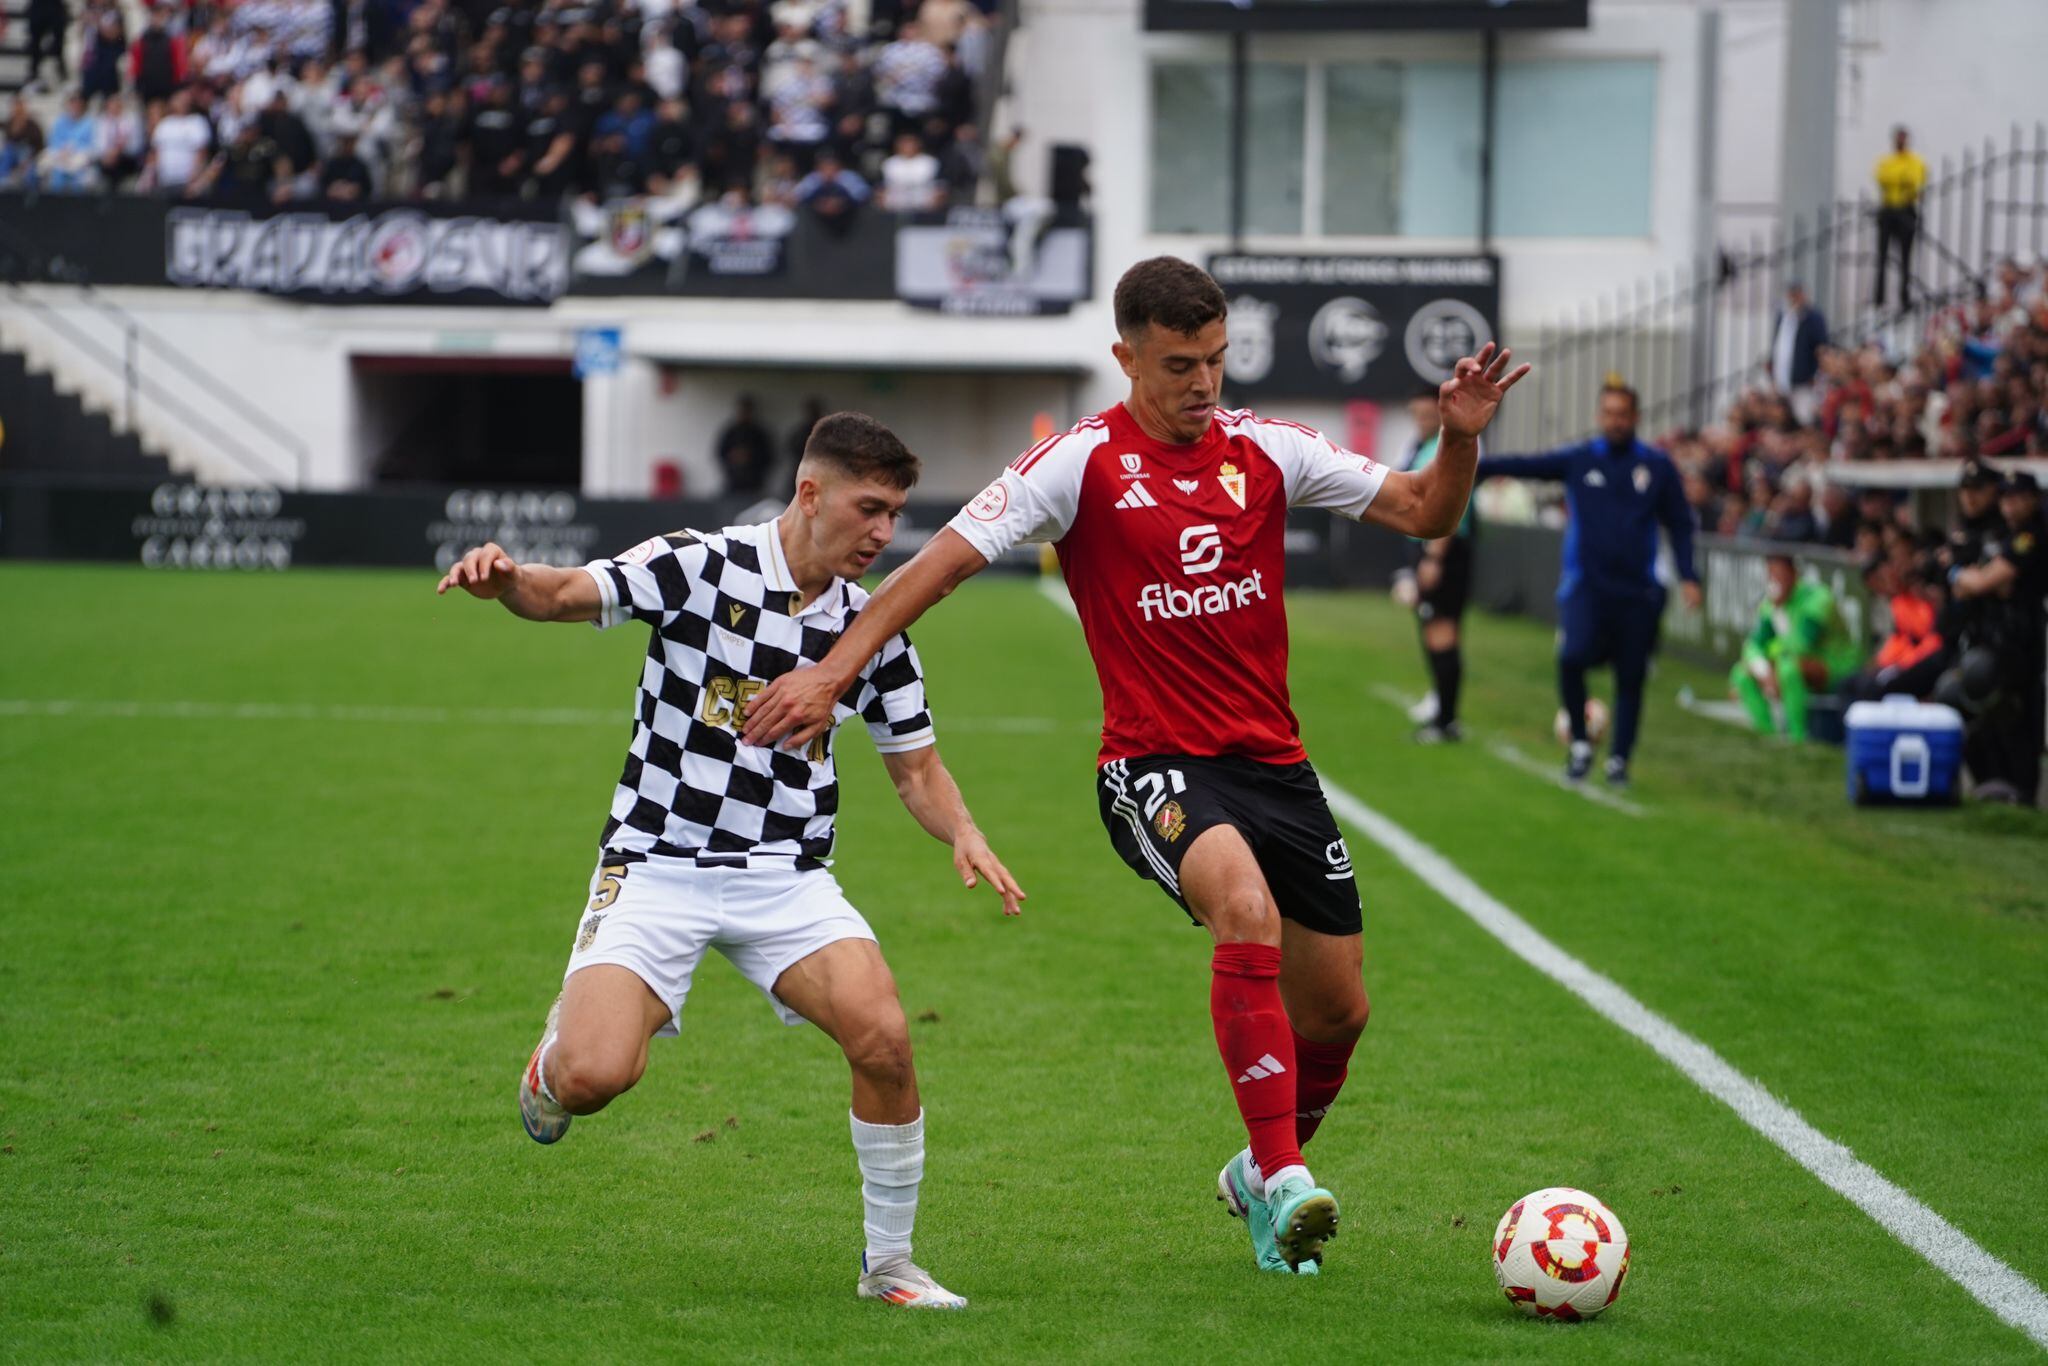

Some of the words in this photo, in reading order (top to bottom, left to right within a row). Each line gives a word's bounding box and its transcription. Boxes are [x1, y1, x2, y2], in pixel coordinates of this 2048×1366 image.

[1137, 568, 1267, 622] fibranet
[1134, 769, 1187, 821] 21
[590, 864, 629, 912] 5
